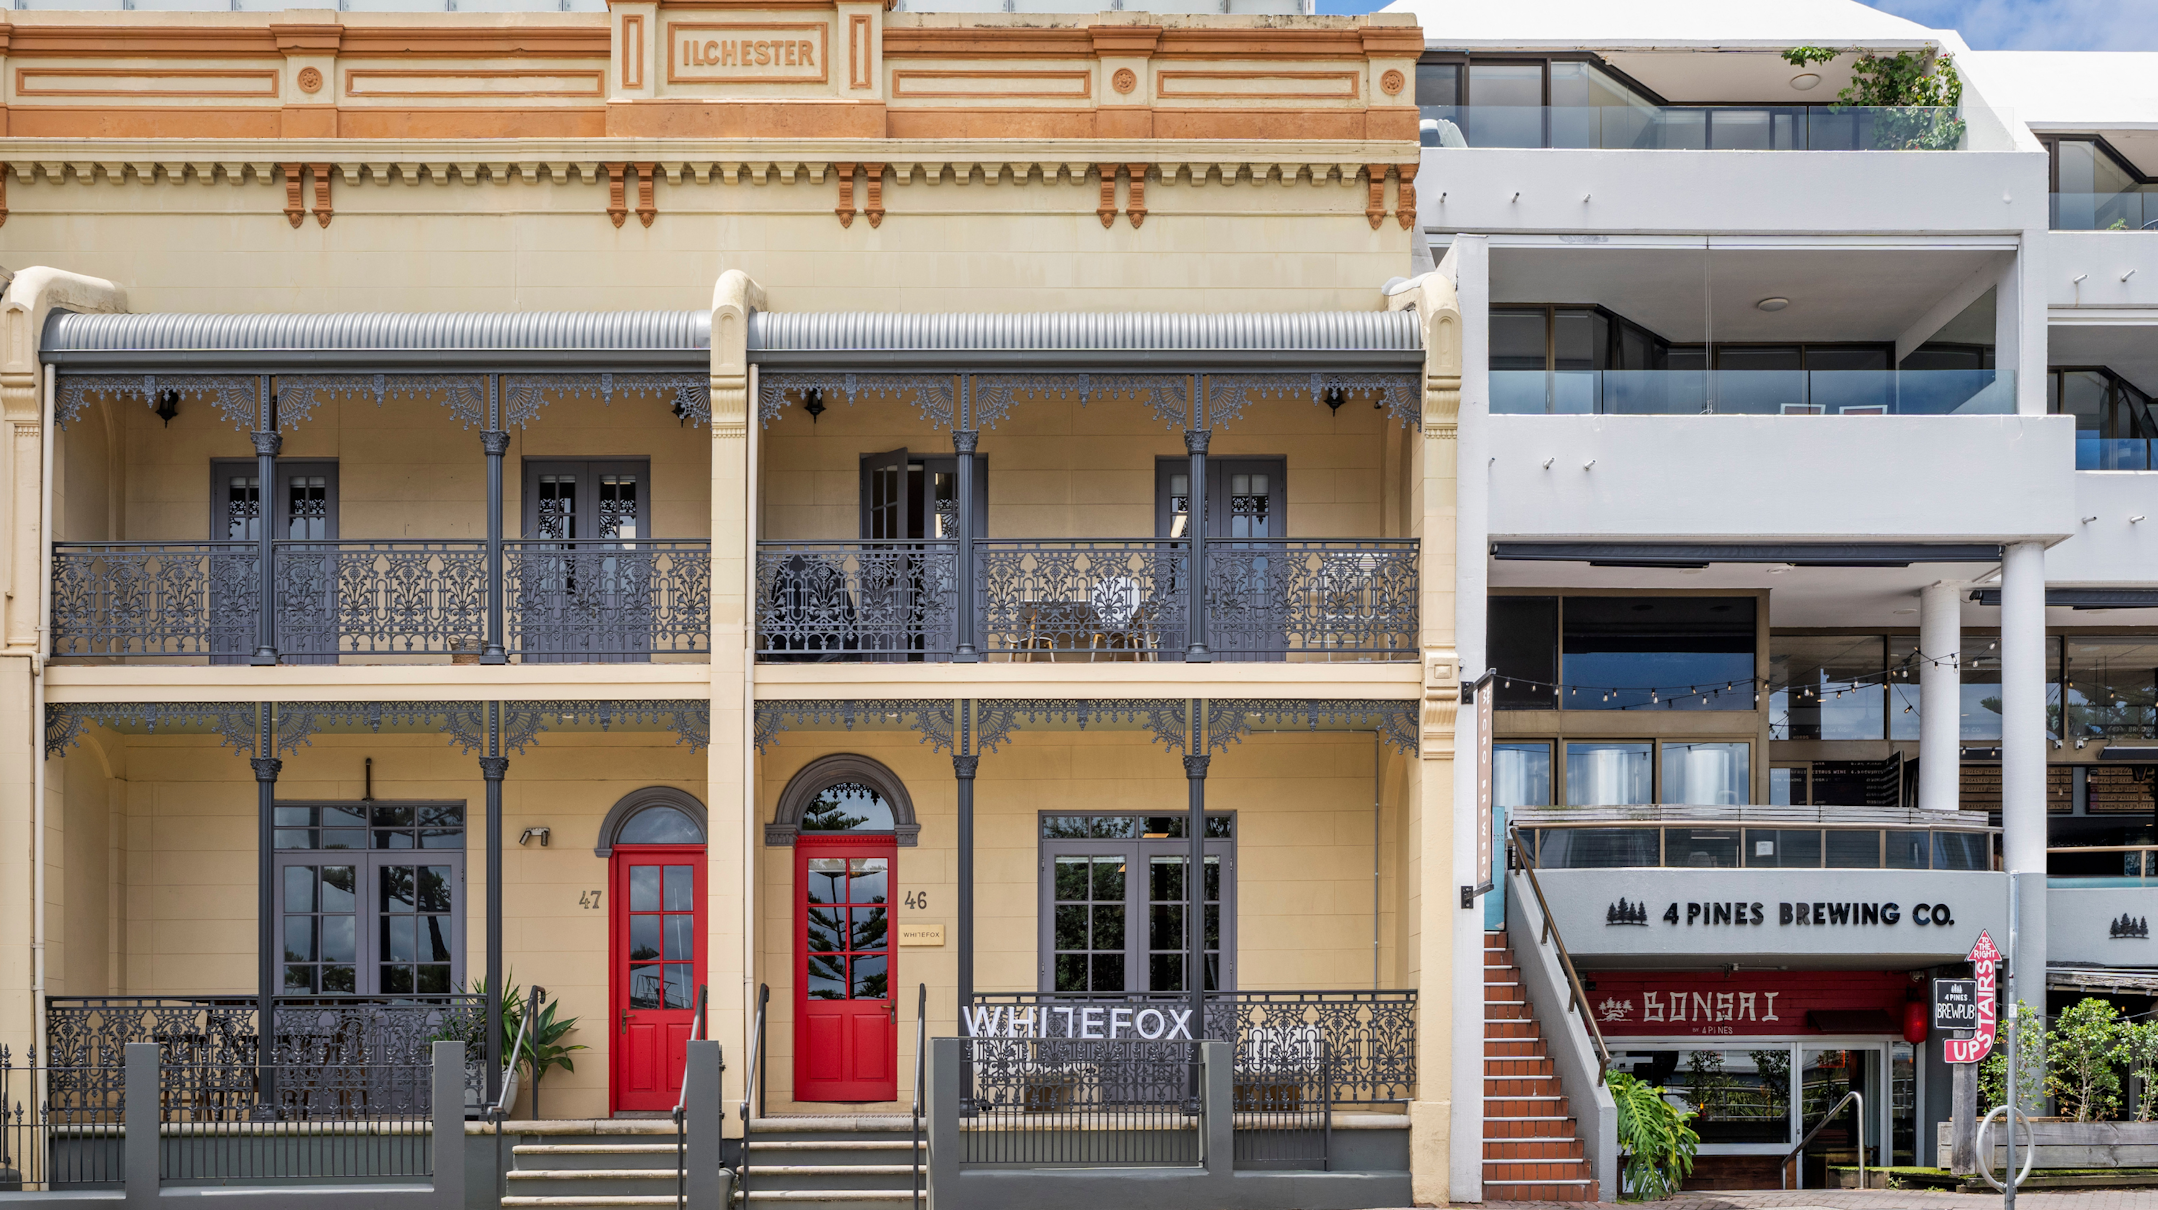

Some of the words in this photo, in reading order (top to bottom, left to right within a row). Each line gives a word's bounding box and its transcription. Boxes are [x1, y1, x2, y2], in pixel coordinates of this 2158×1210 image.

[683, 40, 815, 66] ILCHESTER
[579, 891, 602, 910] 47
[904, 890, 927, 910] 46
[1663, 902, 1679, 925] 4
[1687, 902, 1764, 926] PINES
[1779, 902, 1902, 926] BREWING
[1912, 903, 1955, 926] CO.
[1974, 950, 1996, 959] RIGHT
[1978, 943, 1992, 951] THE
[1643, 991, 1780, 1022] BONSAI
[1937, 1003, 1975, 1020] BREWPUB
[1953, 959, 1994, 1061] UPSTAIRS
[963, 1006, 1194, 1039] WHITEFOX
[1708, 1026, 1733, 1034] PINES
